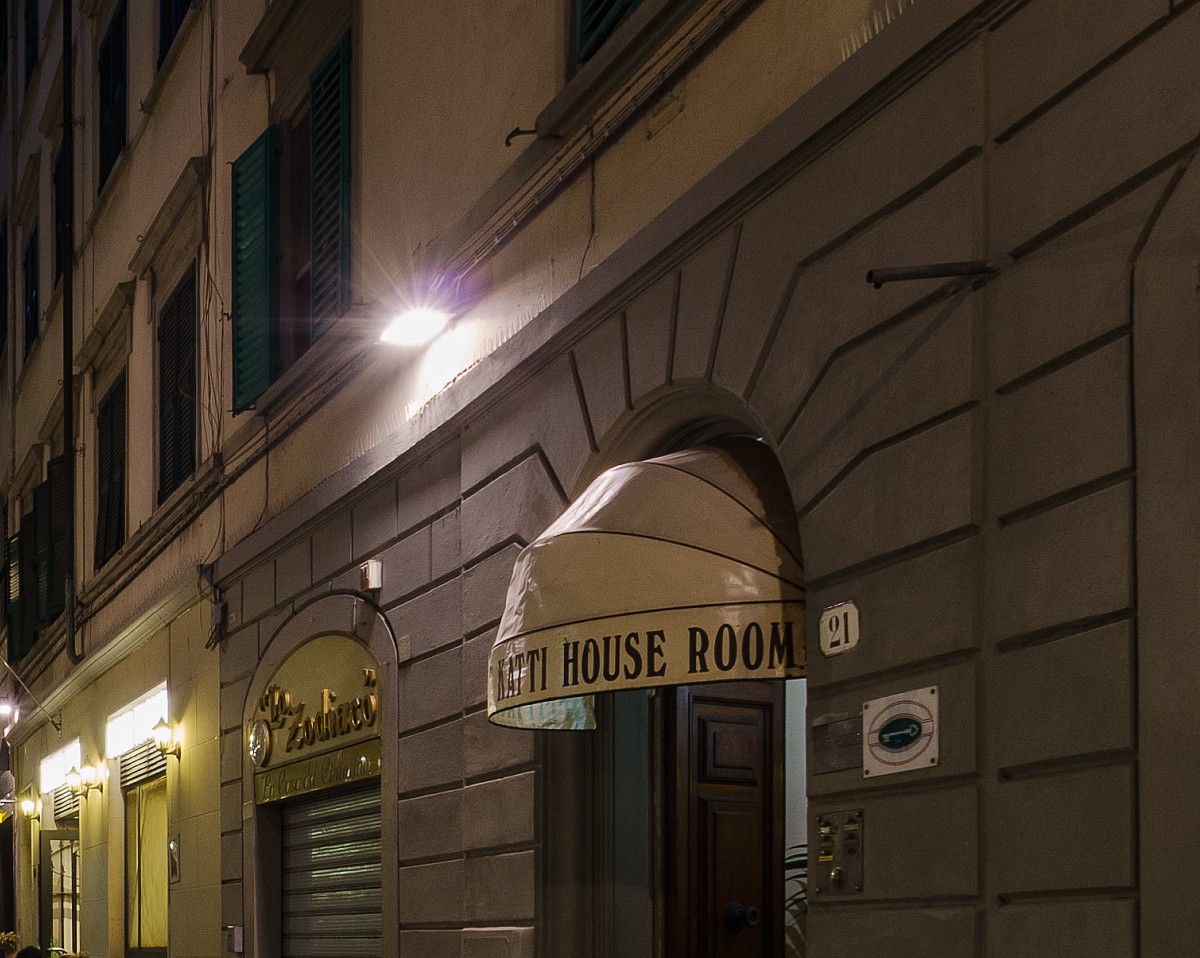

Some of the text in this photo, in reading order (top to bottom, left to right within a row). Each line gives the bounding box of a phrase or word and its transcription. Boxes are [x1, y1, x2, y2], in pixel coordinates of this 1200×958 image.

[828, 612, 851, 648] 21
[496, 621, 807, 702] KATTI HOUSE ROOM
